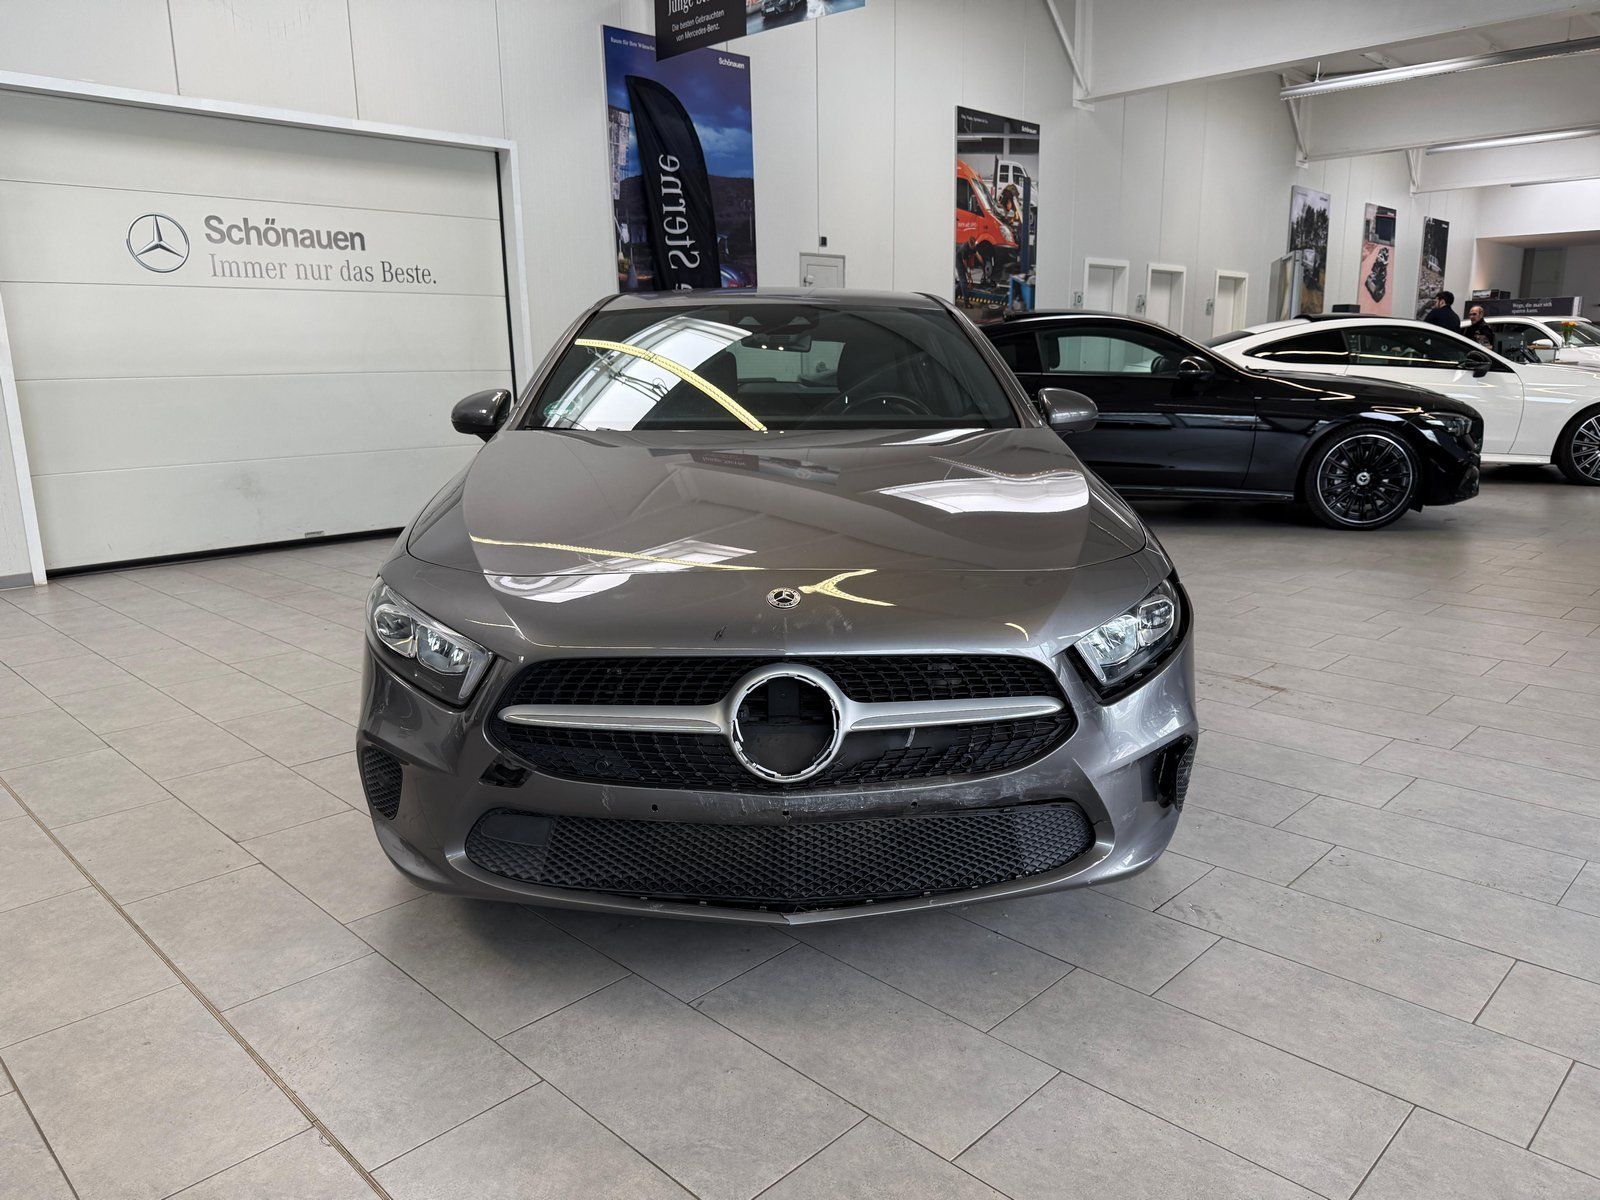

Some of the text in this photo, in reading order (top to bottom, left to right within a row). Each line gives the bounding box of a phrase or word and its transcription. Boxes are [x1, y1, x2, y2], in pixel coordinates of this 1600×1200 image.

[671, 9, 725, 32] Die besten Gebrauchten
[675, 34, 684, 42] von
[718, 57, 745, 69] Schönauen
[204, 214, 366, 251] Schönauen
[208, 253, 437, 285] Immer nur das Beste.
